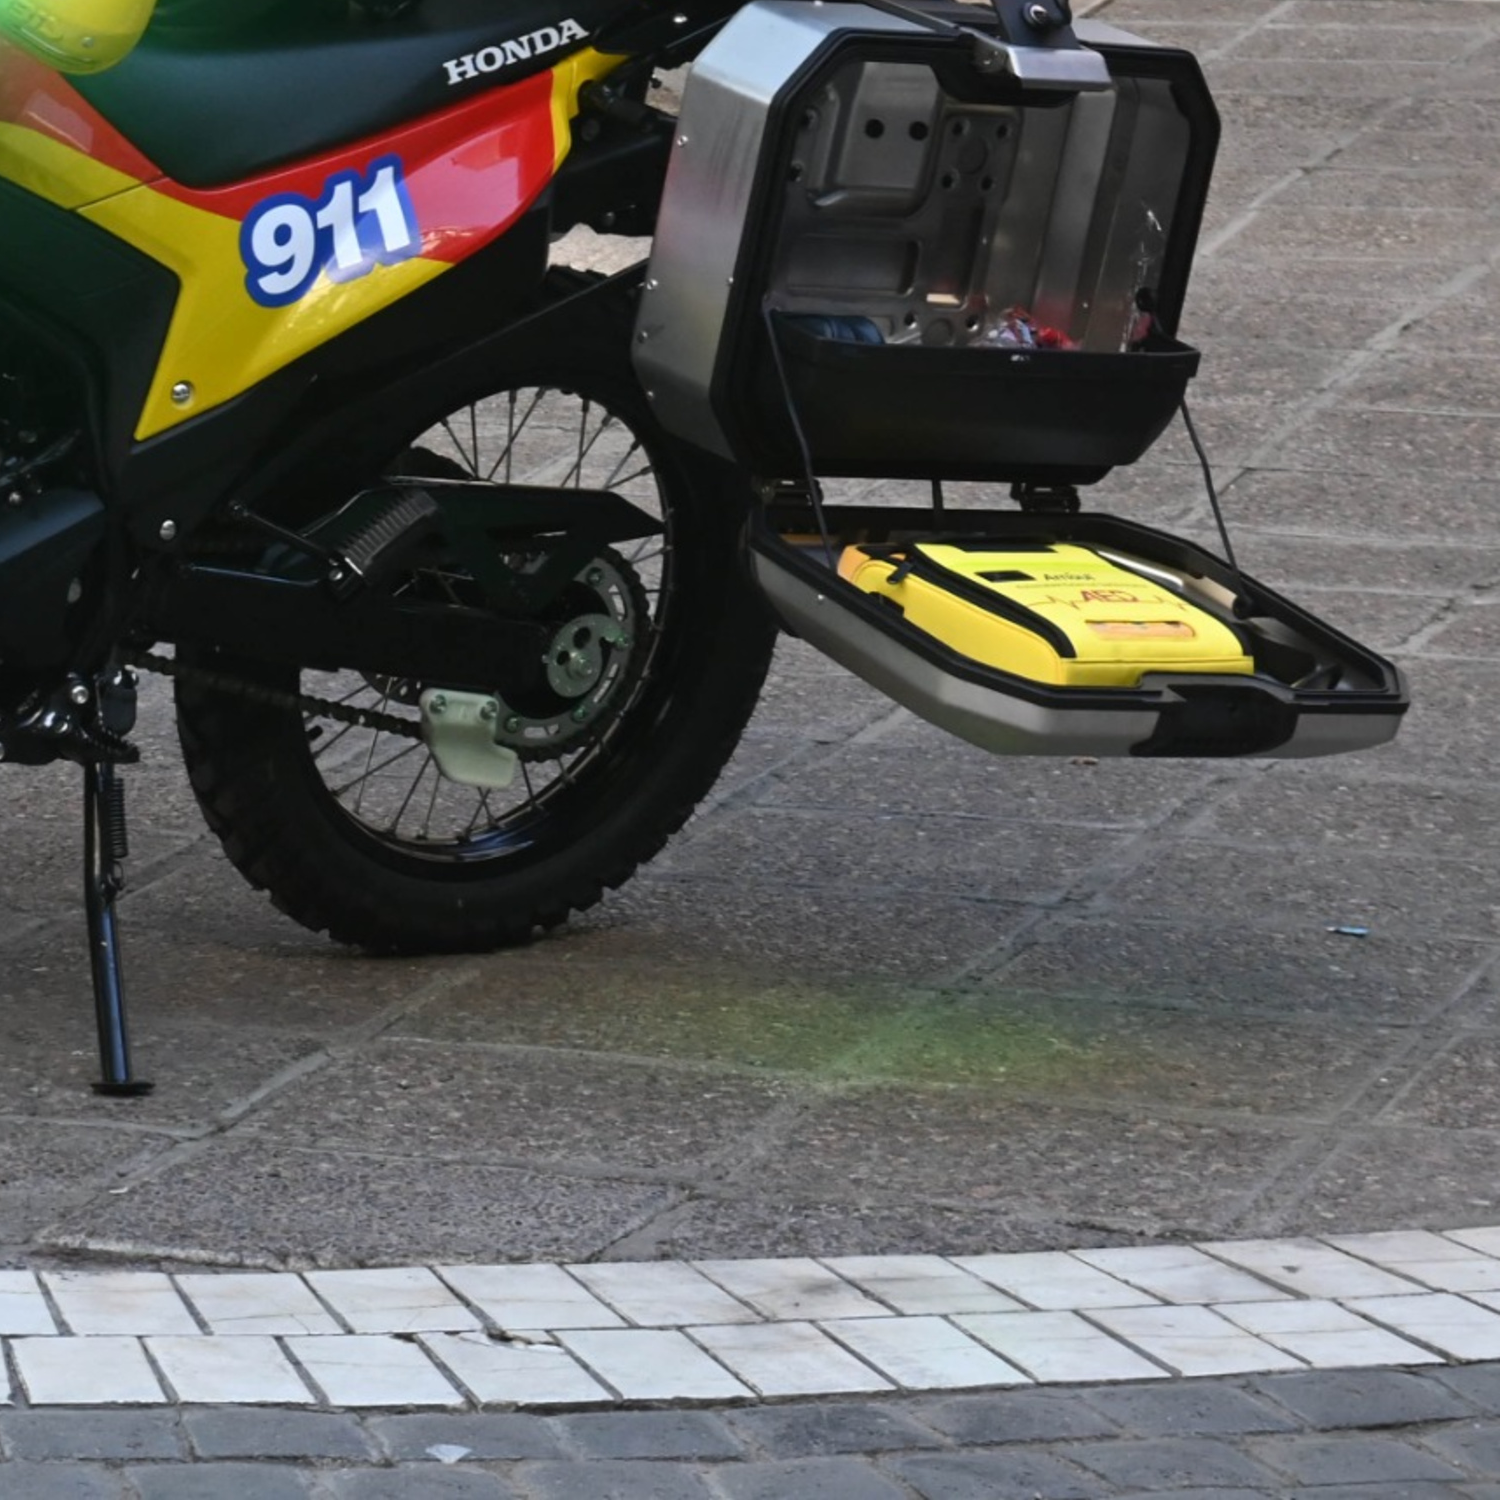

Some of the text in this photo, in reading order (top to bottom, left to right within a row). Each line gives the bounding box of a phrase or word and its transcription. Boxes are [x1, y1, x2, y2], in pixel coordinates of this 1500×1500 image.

[443, 18, 589, 85] HONDA
[251, 165, 411, 295] 911
[1080, 589, 1140, 603] AED
